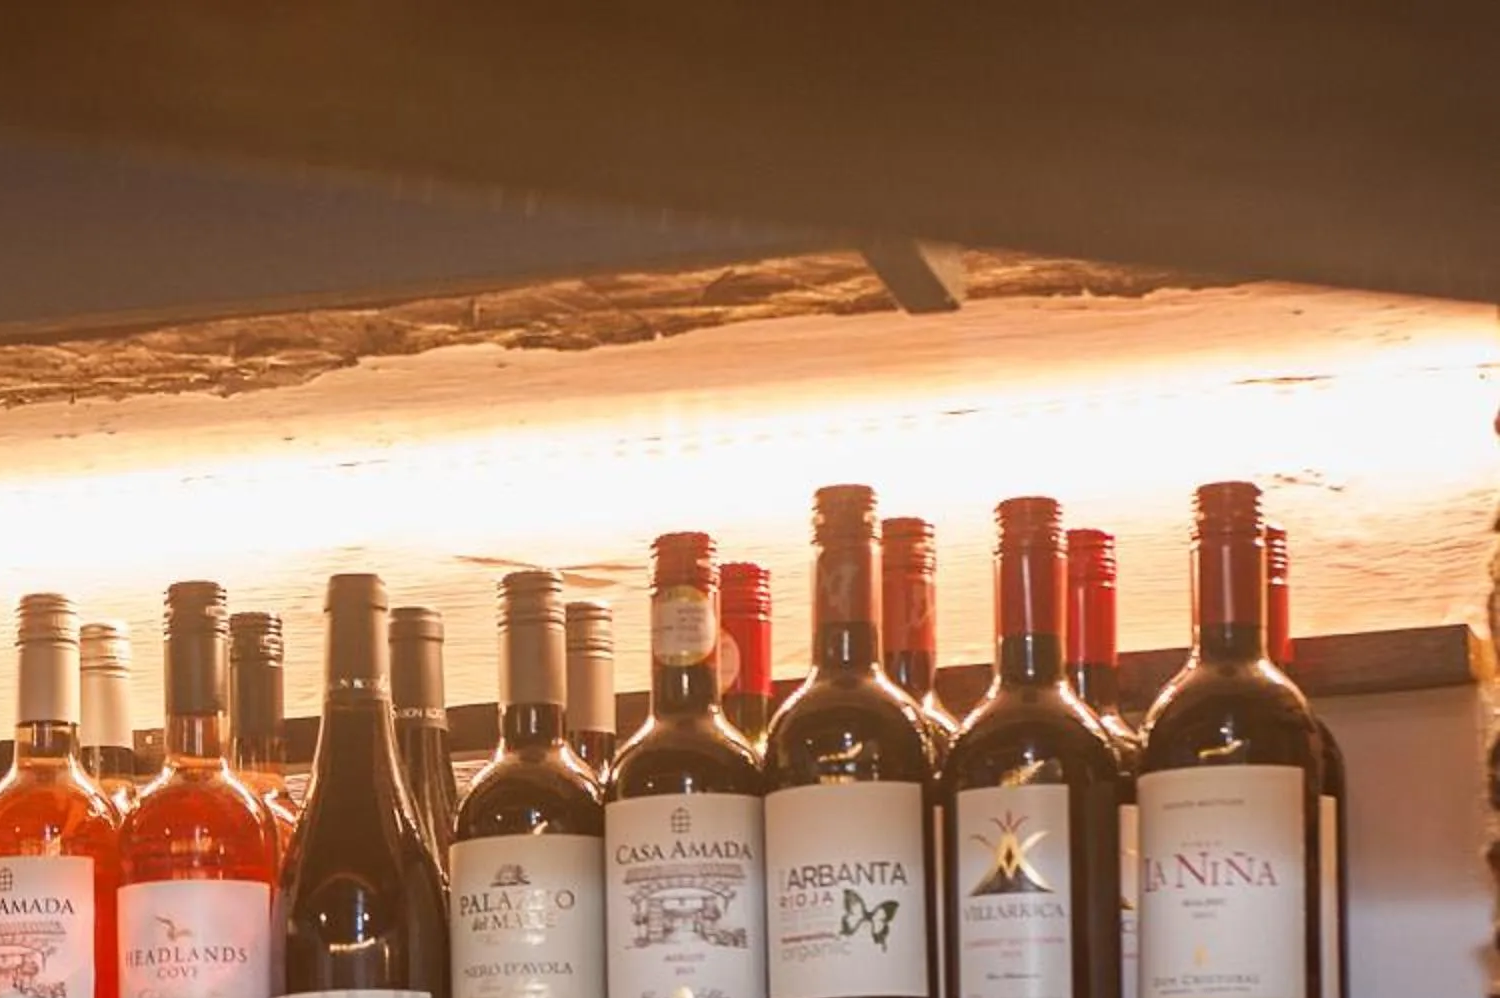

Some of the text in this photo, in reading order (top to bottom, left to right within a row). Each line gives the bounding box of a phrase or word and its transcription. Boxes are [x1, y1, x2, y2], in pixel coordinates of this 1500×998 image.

[615, 839, 755, 866] CASA AMADA
[787, 861, 908, 891] ARBANTA
[1144, 851, 1279, 893] LA NIÑA
[779, 890, 834, 909] RIOJA
[125, 946, 248, 968] HEADLANDS
[157, 966, 198, 979] COVE
